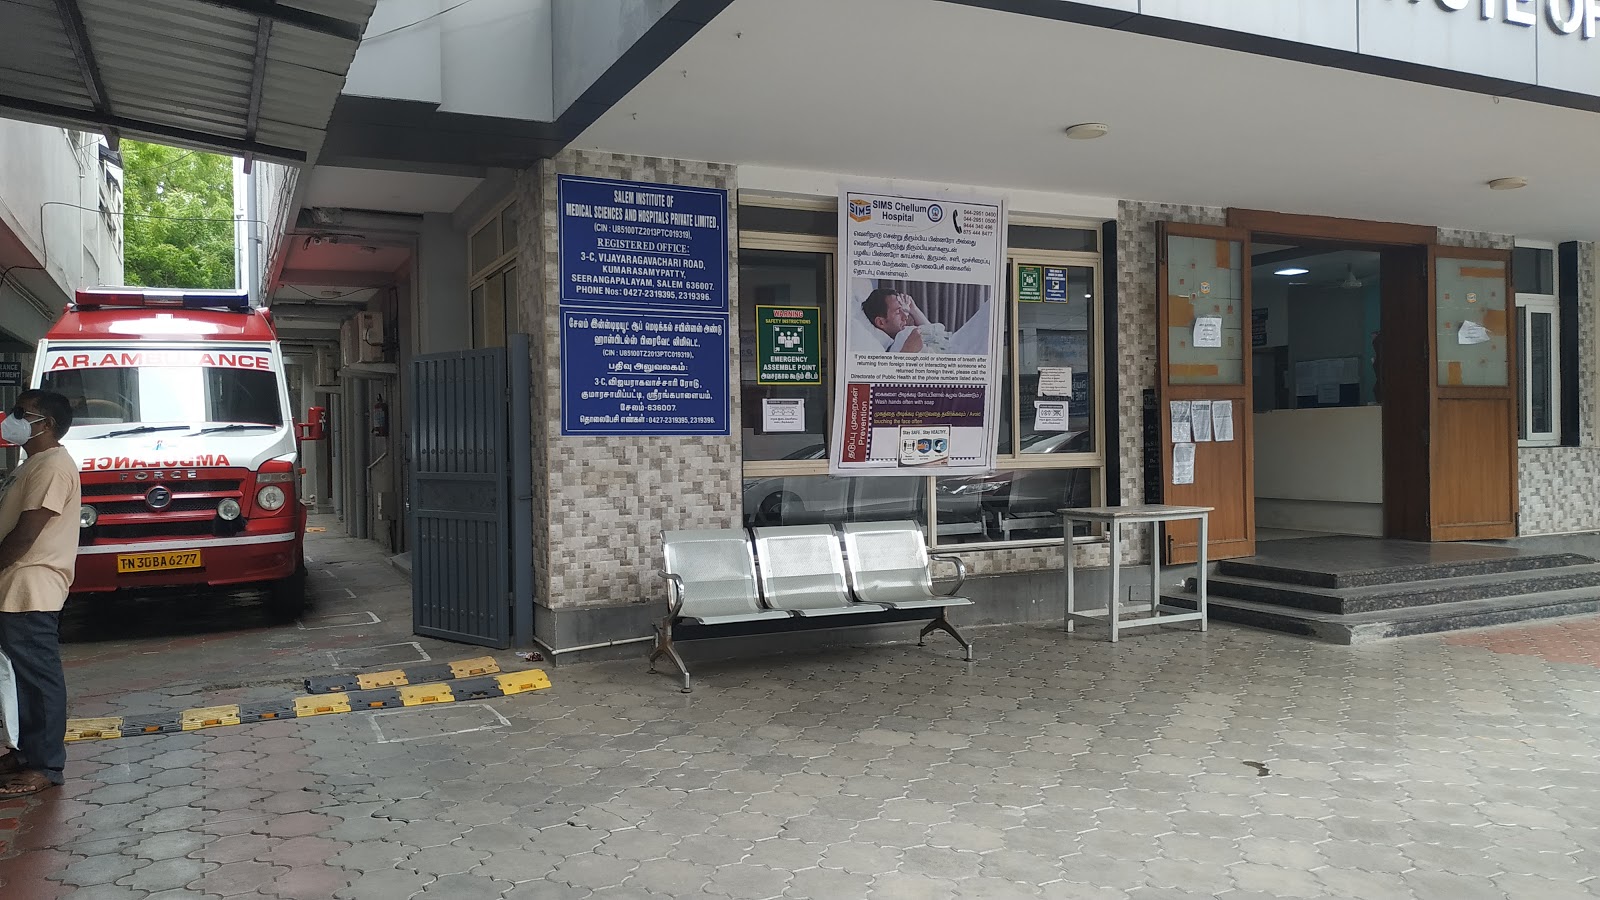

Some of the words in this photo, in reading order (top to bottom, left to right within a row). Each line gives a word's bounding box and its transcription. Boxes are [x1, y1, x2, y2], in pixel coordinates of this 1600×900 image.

[614, 190, 634, 204] SALEM
[636, 192, 665, 207] INSTITUTE
[667, 195, 674, 208] OF
[850, 203, 871, 216] SIMS
[873, 200, 892, 210] SIMS
[895, 202, 927, 213] Chellum
[566, 203, 592, 218] MEDICAL
[594, 206, 622, 220] SCIENCES
[624, 208, 637, 222] AND
[638, 210, 669, 225] HOSPITALS
[671, 213, 693, 227] PRIVATE
[694, 215, 719, 230] LIMITED,
[882, 212, 914, 224] Hospital
[854, 231, 882, 239] வெளிநாடு
[883, 233, 902, 241] சென்று
[597, 238, 655, 251] REGISTERED
[656, 242, 690, 253] OFFICE:
[581, 252, 597, 263] 3-C,
[598, 253, 681, 267] VIJAYARAGAVACHARI
[683, 260, 706, 270] ROAD,
[602, 265, 686, 279] KUMARASAMYPATTY,
[572, 274, 654, 287] SEERANGAPALAYAM,
[657, 279, 683, 288] SALEM
[686, 282, 714, 291] 636007.
[576, 286, 603, 295] PHONE
[623, 289, 677, 300] 0427-2319395,
[679, 292, 711, 300] 2319396.
[773, 310, 804, 318] WARNING
[569, 317, 588, 328] சேலம்
[632, 320, 643, 332] ஆப்
[704, 323, 722, 335] அண்டு
[609, 361, 632, 372] பதிவு
[608, 377, 678, 387] விஜயராகவாச்சாரி
[680, 379, 702, 388] ரோடு,
[581, 389, 644, 400] குமாரசாமிப்பட்டி,
[851, 387, 859, 430] முறைகள்
[580, 414, 620, 425] தொலைபேசி
[858, 401, 867, 445] Prevention
[847, 432, 858, 459] தடுப்பு
[120, 470, 197, 480] FORCE
